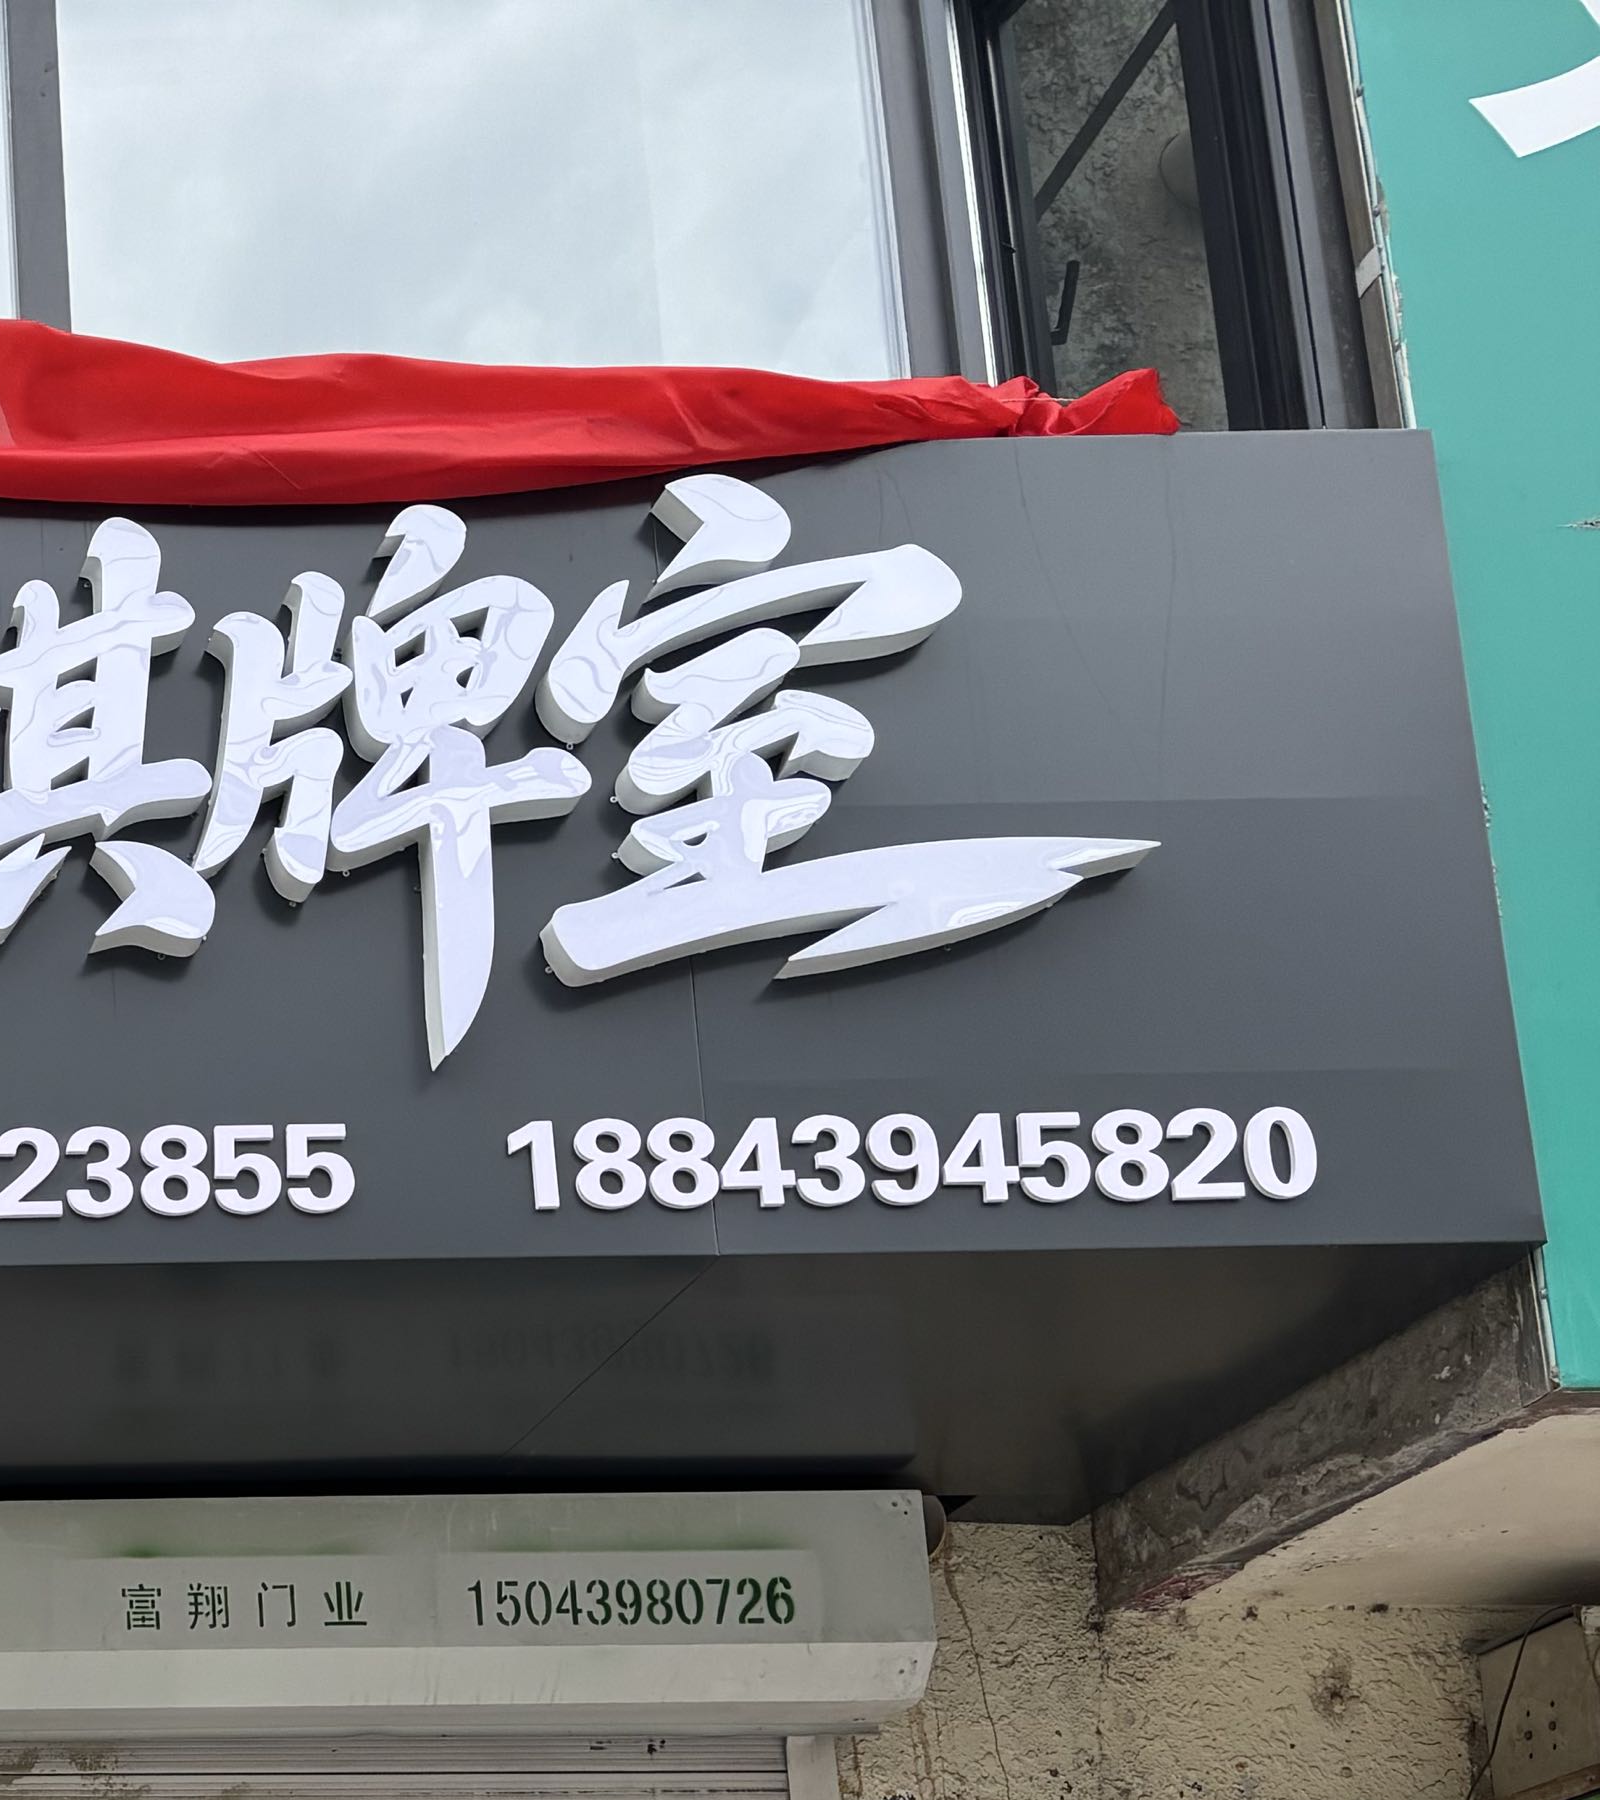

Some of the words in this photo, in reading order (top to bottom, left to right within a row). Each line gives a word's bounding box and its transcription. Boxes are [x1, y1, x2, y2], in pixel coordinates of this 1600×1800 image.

[506, 1105, 1319, 1210] 18843945820
[122, 1581, 368, 1631] 富翔门业
[468, 1576, 795, 1627] 15043980726
